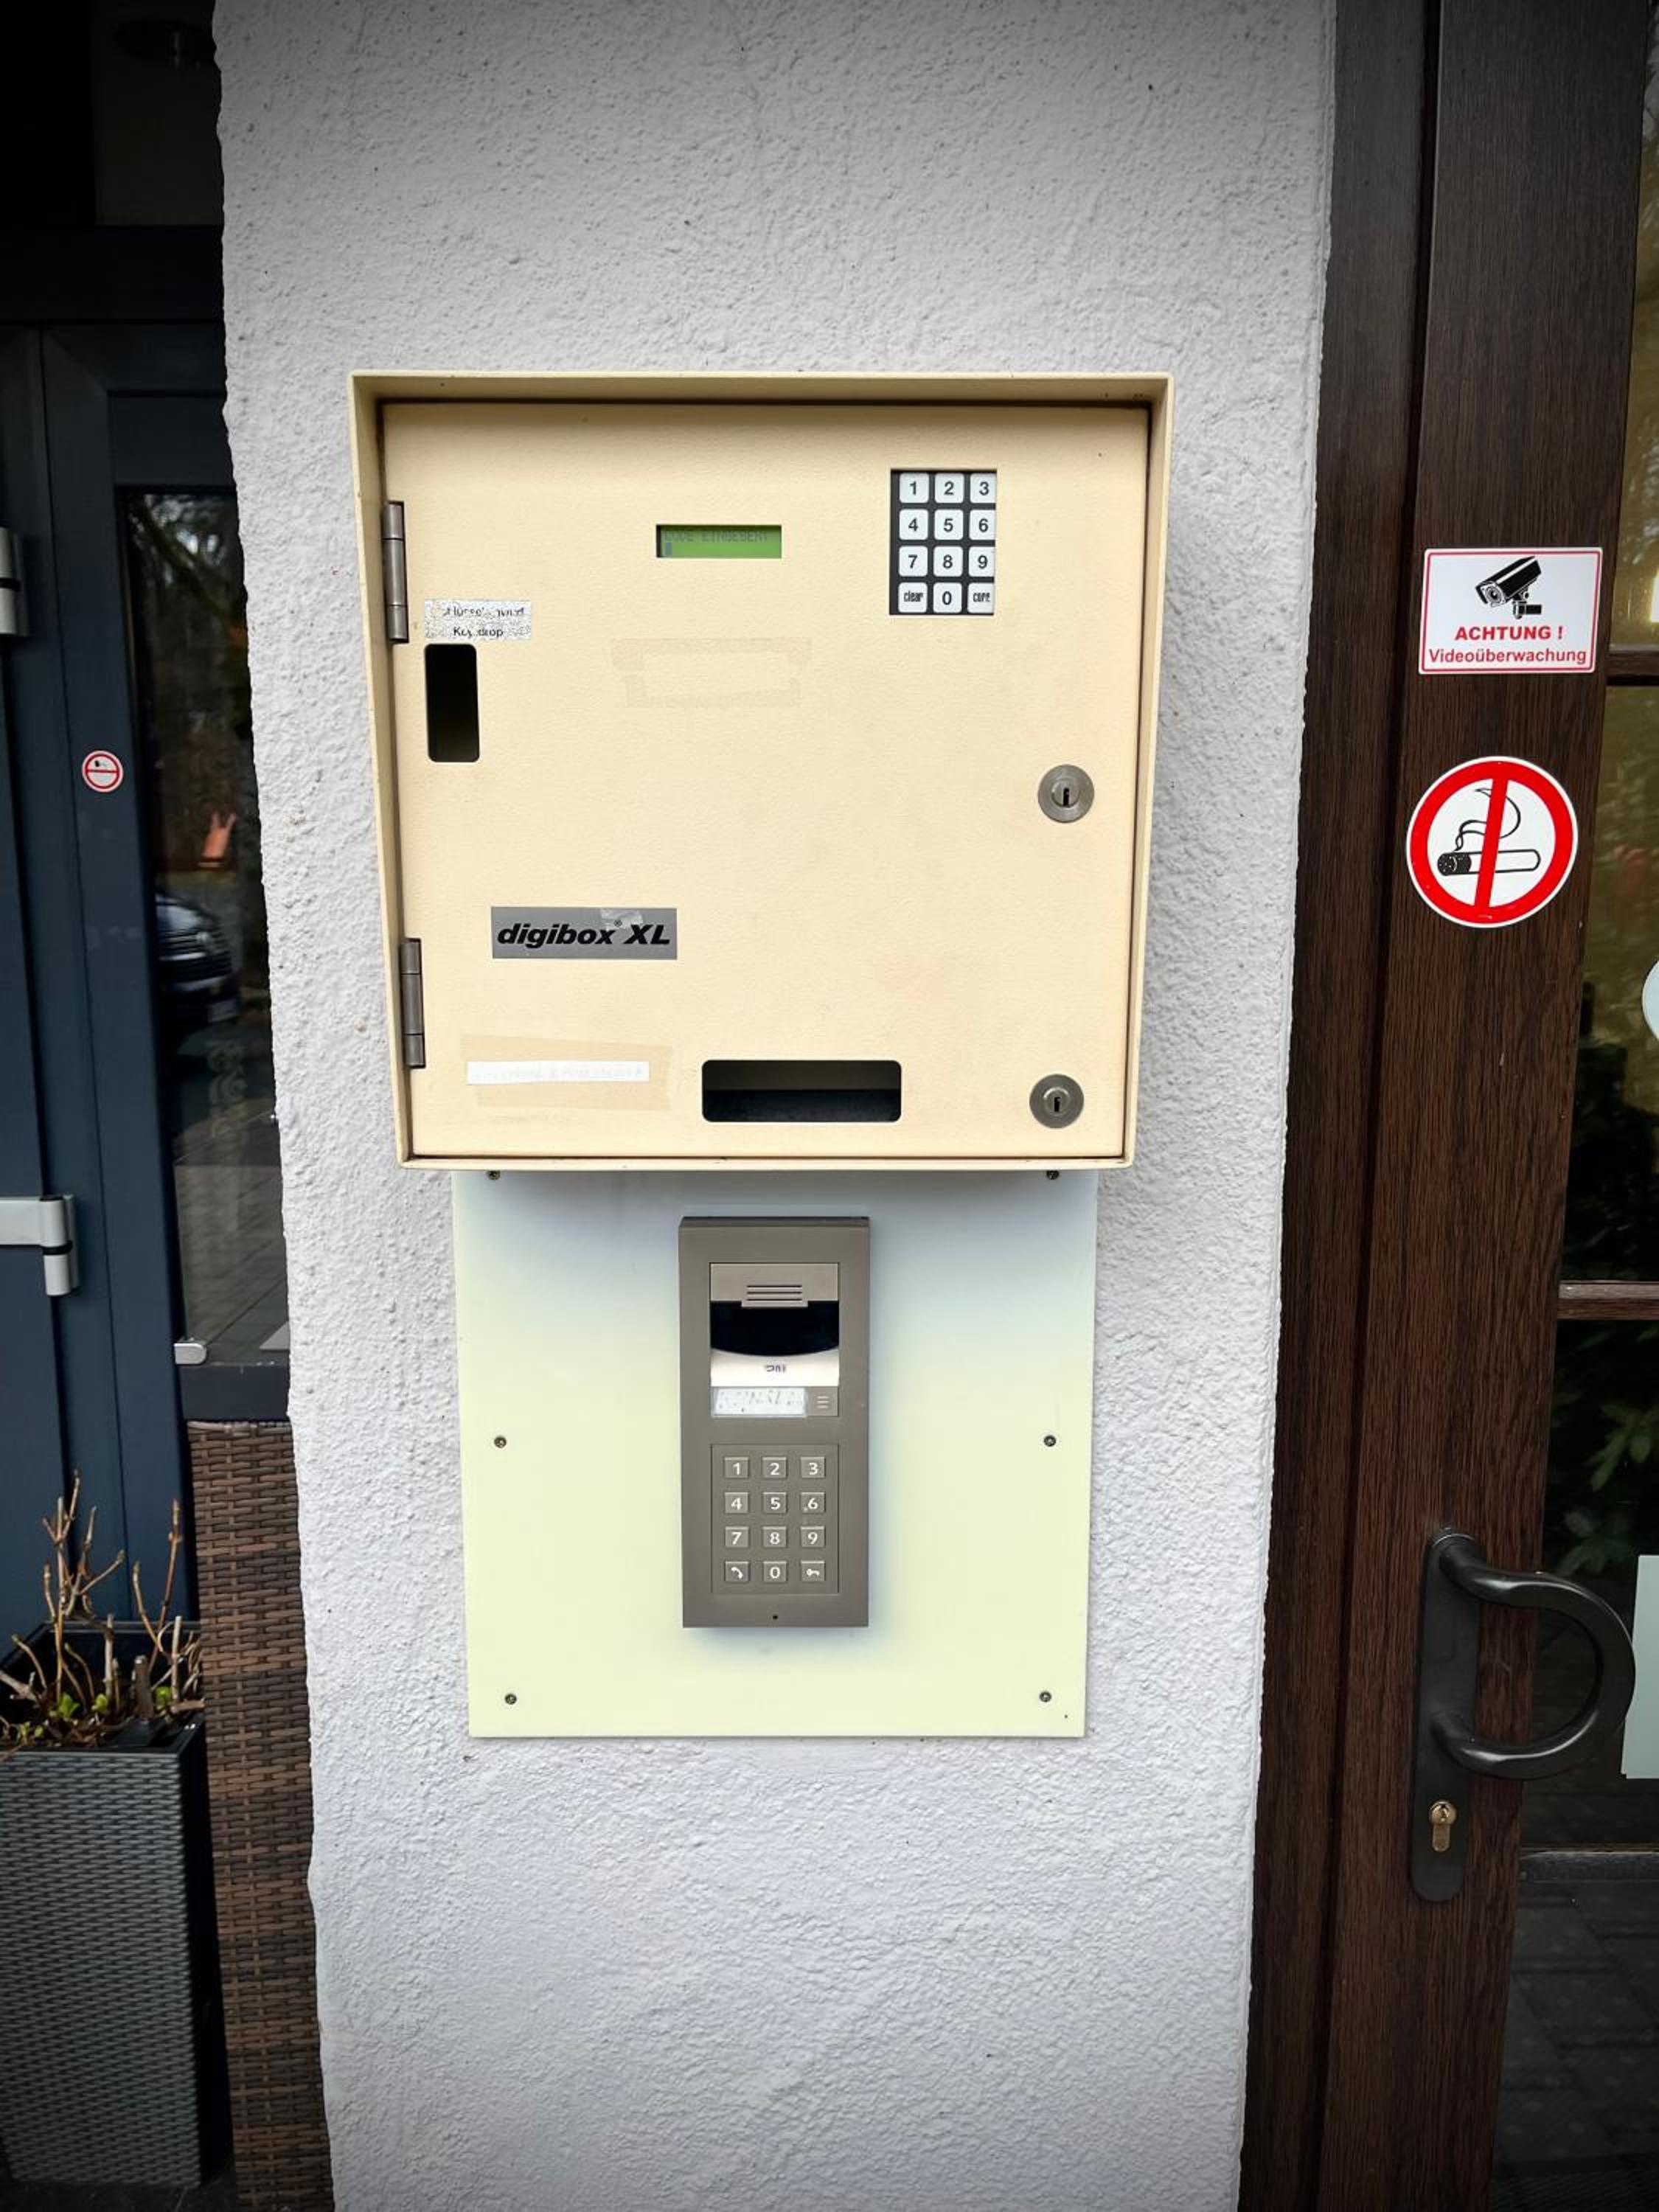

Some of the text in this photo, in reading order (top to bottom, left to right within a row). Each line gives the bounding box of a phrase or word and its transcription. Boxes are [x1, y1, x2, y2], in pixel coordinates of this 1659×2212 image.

[909, 481, 990, 495] 1 2 3
[908, 518, 989, 532] 4 5 6
[908, 554, 988, 569] 7 8 9
[903, 591, 924, 602] clear
[942, 591, 952, 605] 0
[1455, 626, 1563, 640] ACHTUNG !
[1429, 648, 1587, 665] Videoüberwachung
[623, 924, 670, 945] XL
[733, 1462, 818, 1475] 1 2 3
[731, 1497, 818, 1510] 4 5 6
[731, 1531, 818, 1545] 7 8 9
[770, 1566, 781, 1579] 0
